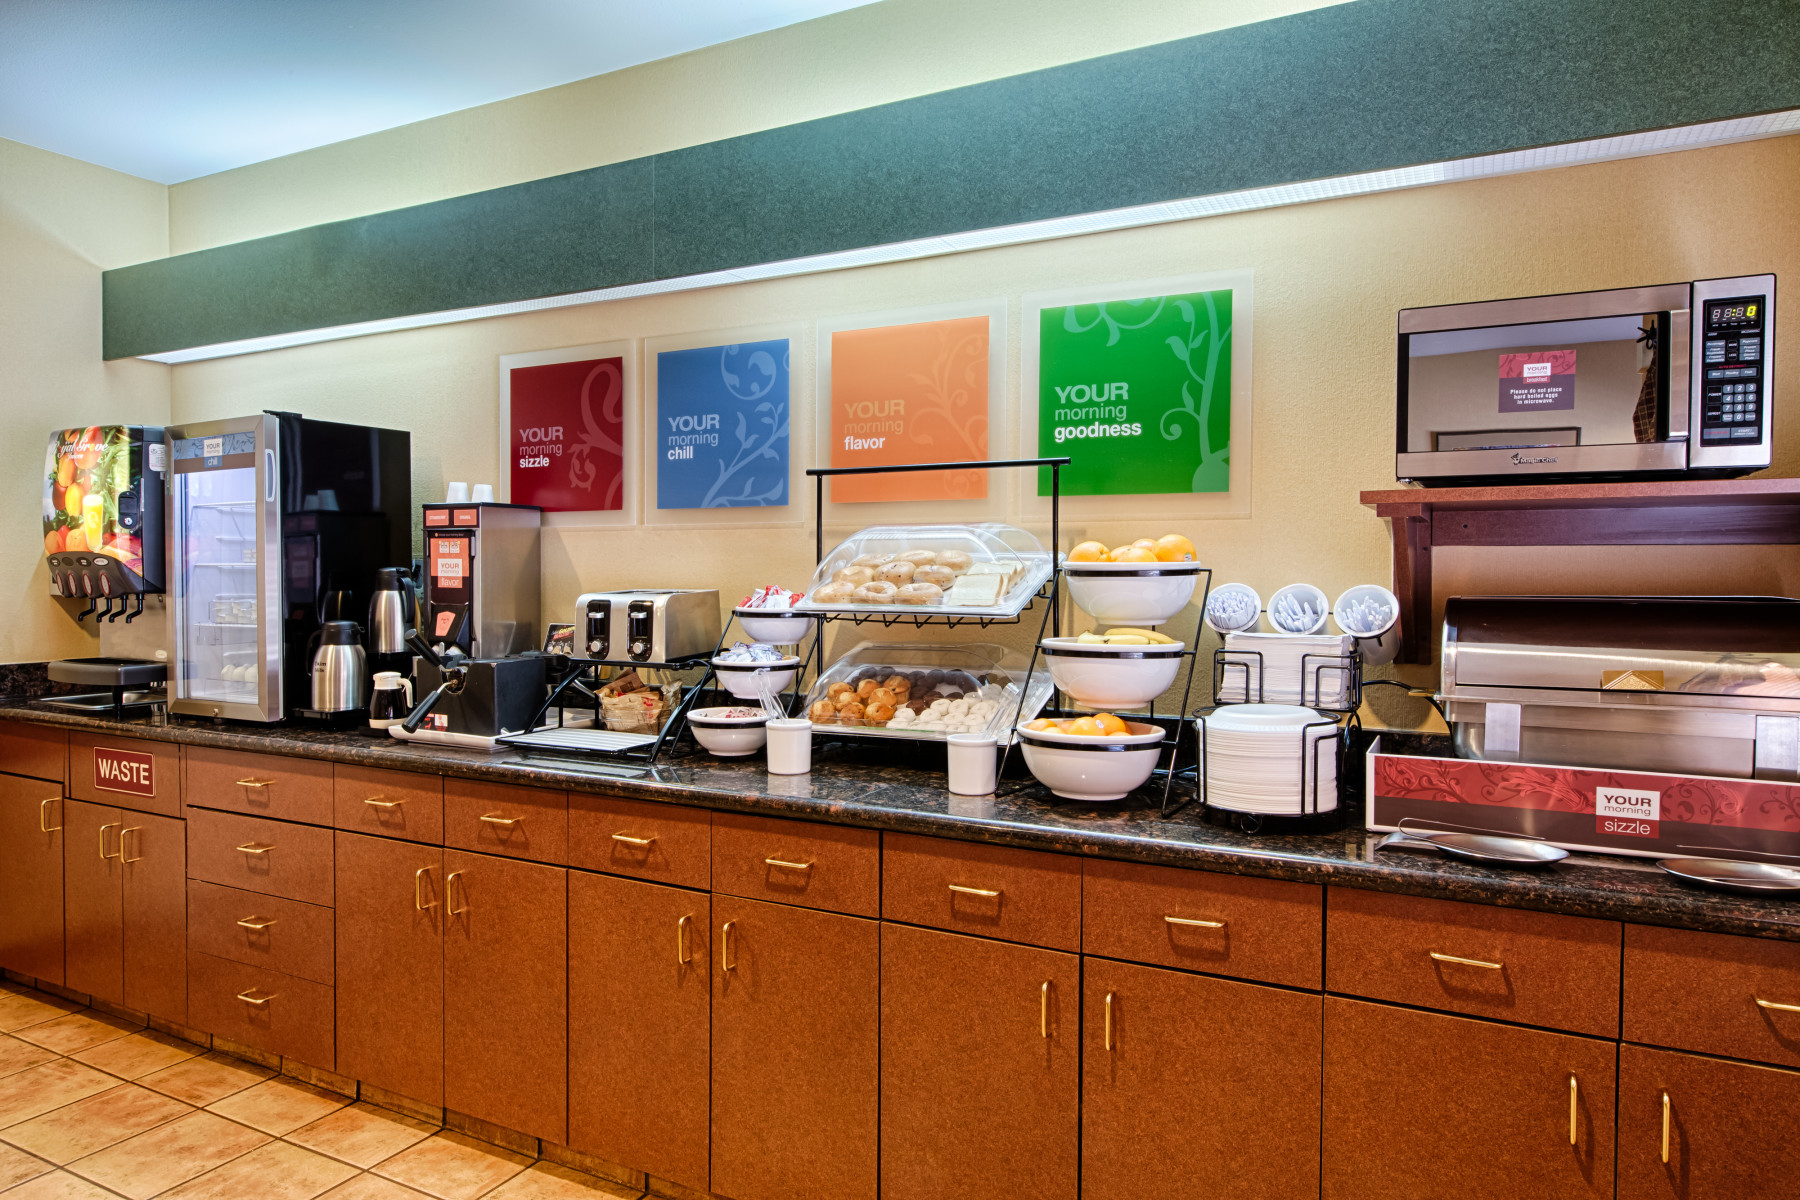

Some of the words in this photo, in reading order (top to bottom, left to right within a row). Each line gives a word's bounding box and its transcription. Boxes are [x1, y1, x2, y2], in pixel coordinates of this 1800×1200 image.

[1054, 382, 1129, 404] YOUR
[843, 399, 905, 419] YOUR
[1055, 403, 1127, 421] morning
[667, 413, 720, 432] YOUR
[844, 418, 904, 435] morning
[519, 426, 564, 443] YOUR
[668, 431, 719, 447] morning
[1054, 421, 1142, 443] goodness
[205, 442, 221, 450] YOUR
[519, 442, 563, 456] morning
[844, 435, 886, 451] flavor
[207, 456, 218, 466] chill
[667, 446, 694, 460] chill
[519, 455, 550, 468] sizzle
[441, 577, 460, 586] flavor
[97, 757, 150, 785] WASTE
[1603, 794, 1652, 807] YOUR
[1603, 805, 1651, 817] morning
[1604, 818, 1651, 835] sizzle
